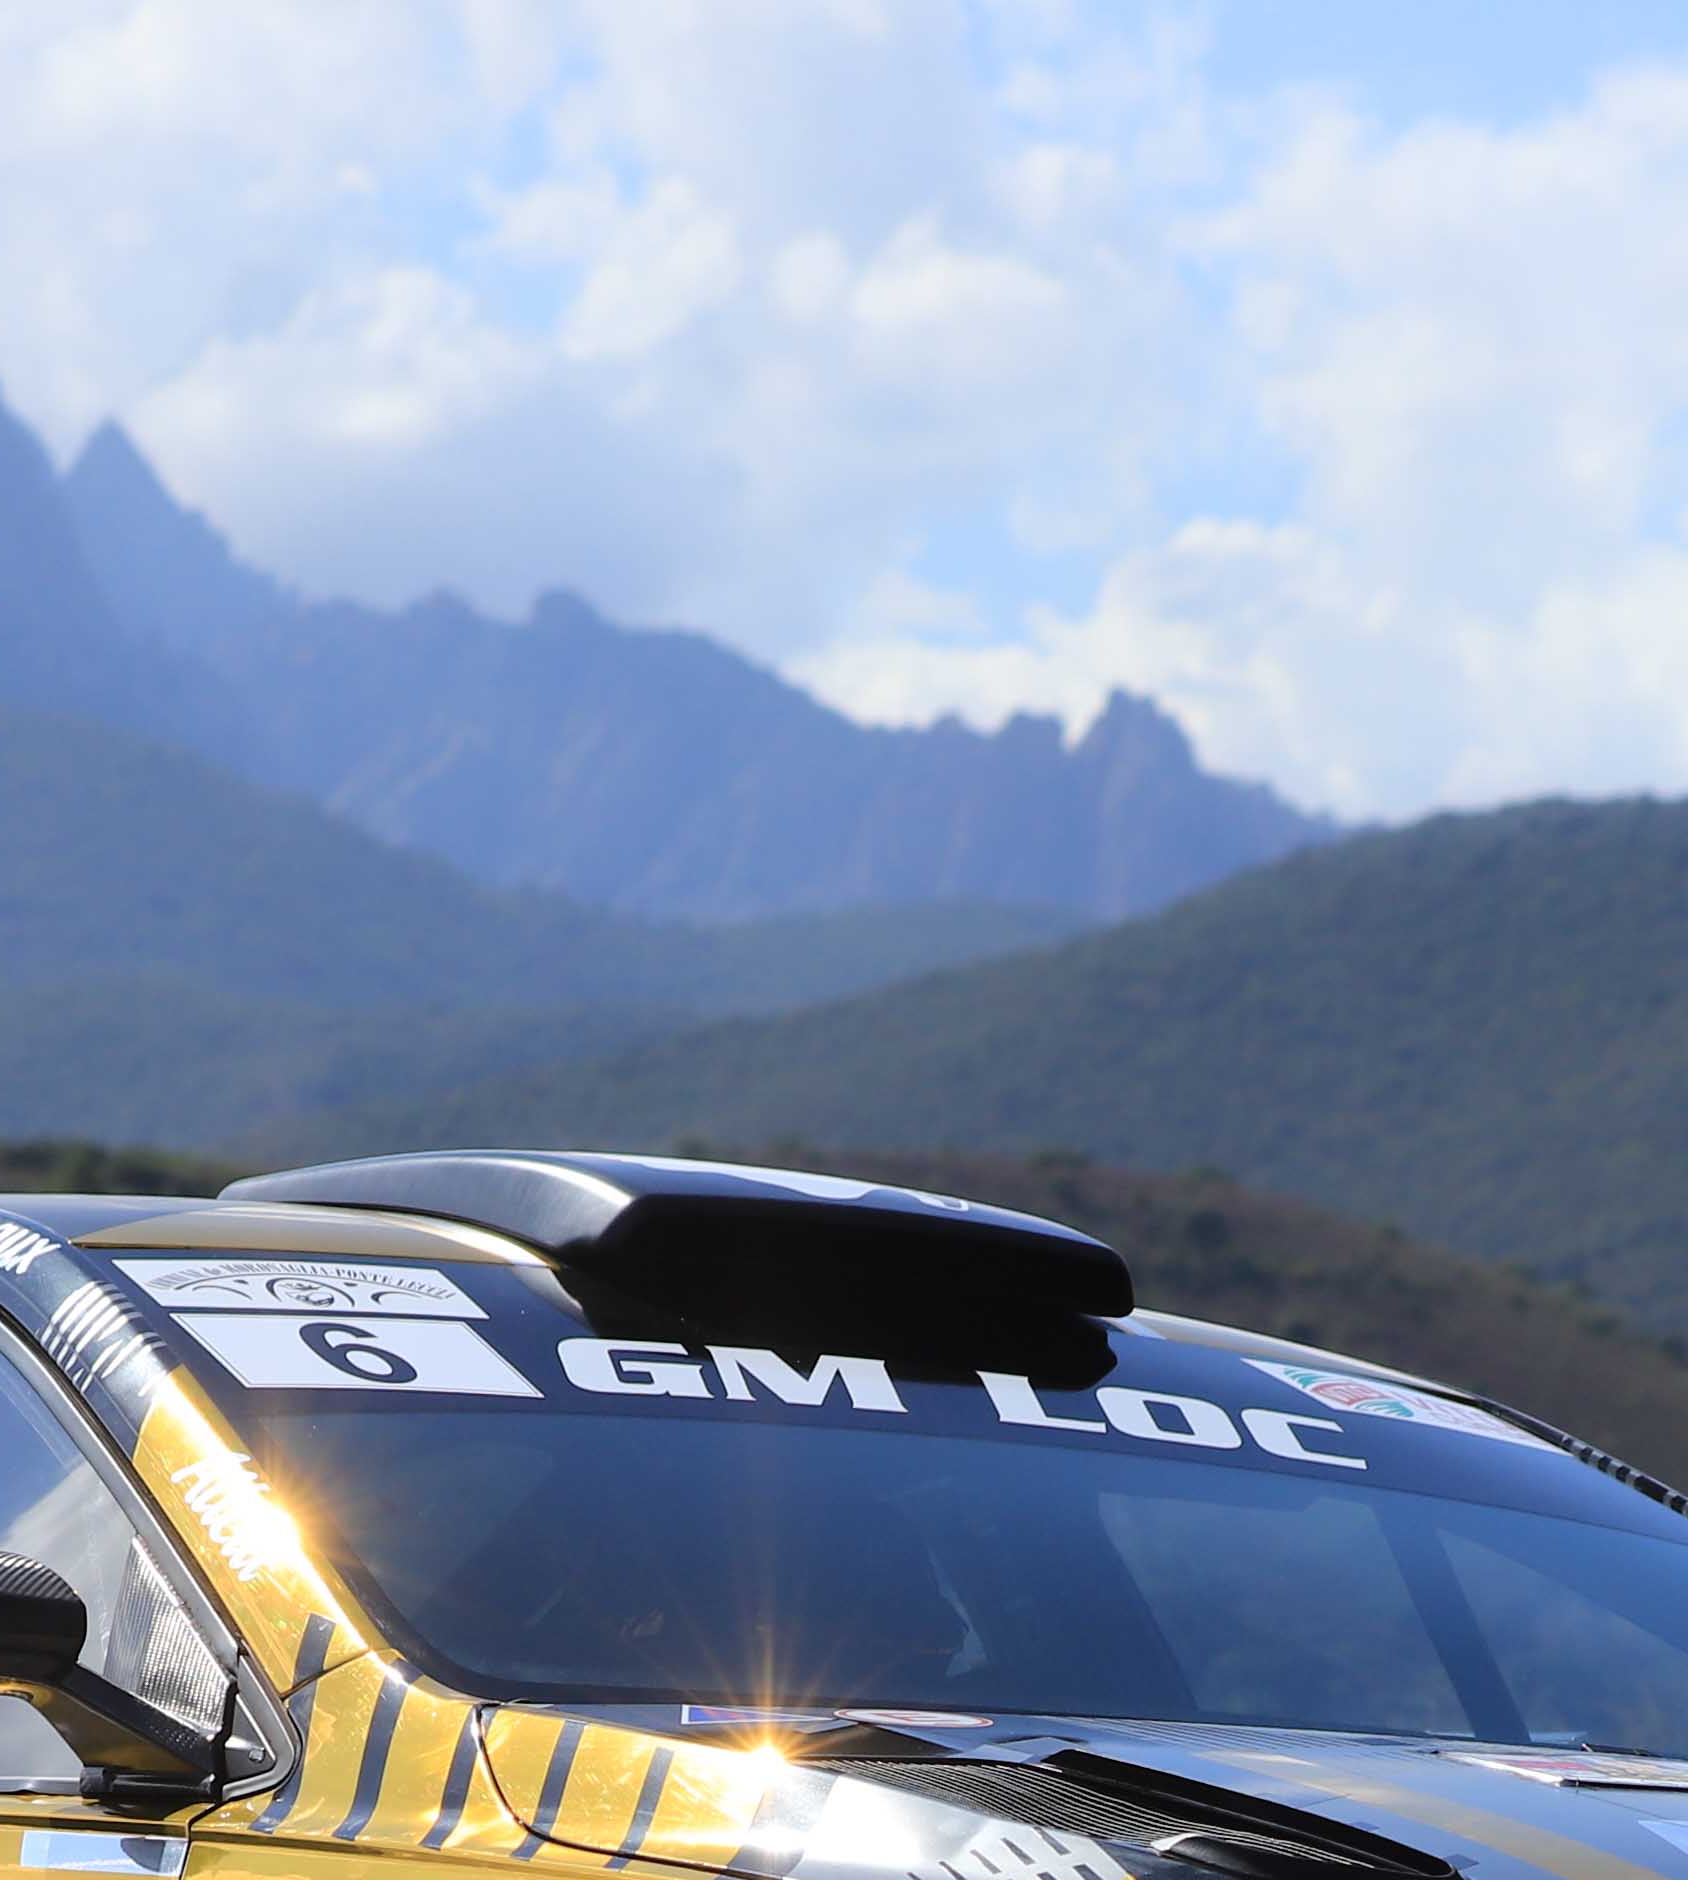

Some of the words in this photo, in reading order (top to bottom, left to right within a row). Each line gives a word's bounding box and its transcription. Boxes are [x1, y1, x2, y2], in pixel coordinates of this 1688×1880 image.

[299, 1323, 417, 1384] 6
[557, 1337, 908, 1412] GM
[976, 1370, 1368, 1469] LOC
